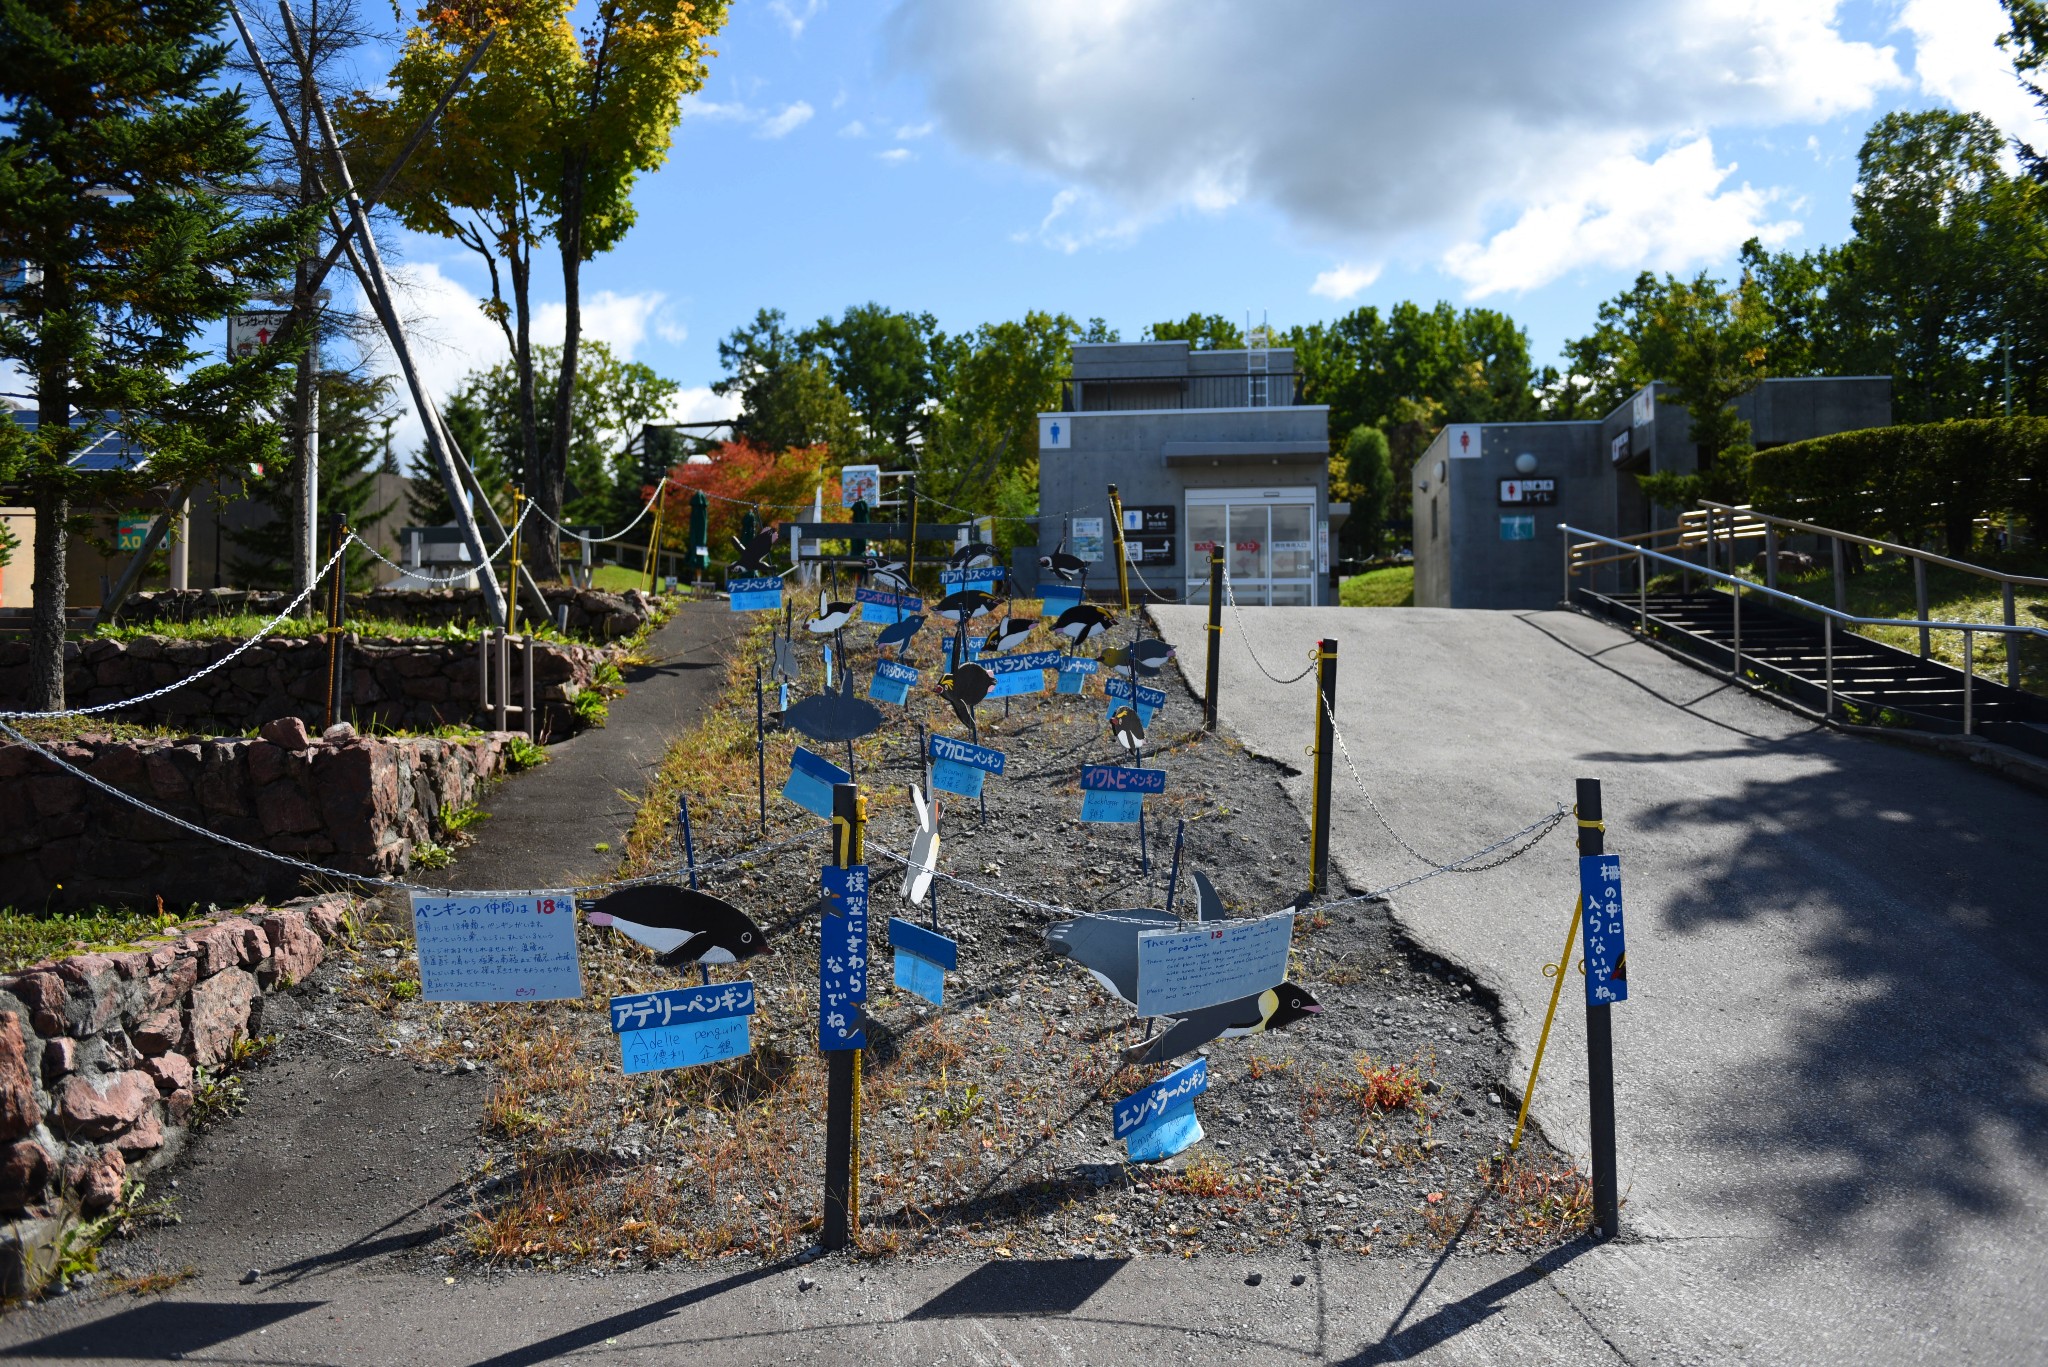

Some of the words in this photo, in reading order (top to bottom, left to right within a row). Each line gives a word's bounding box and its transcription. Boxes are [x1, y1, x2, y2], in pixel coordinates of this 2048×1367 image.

[1146, 512, 1168, 520] トイレ
[121, 535, 142, 548] 入口
[934, 738, 1001, 768] マカロニペンギン
[1085, 767, 1162, 790] イワトビペンギン
[845, 871, 867, 993] 模型にさわら
[1144, 939, 1175, 949] There
[1182, 935, 1202, 943] are
[1210, 930, 1223, 940] 18
[613, 986, 753, 1029] アデリーペンギン
[825, 955, 848, 1038] ないでね。
[628, 1031, 681, 1052] Adelie
[1118, 1069, 1205, 1132] エンペラーペンギン
